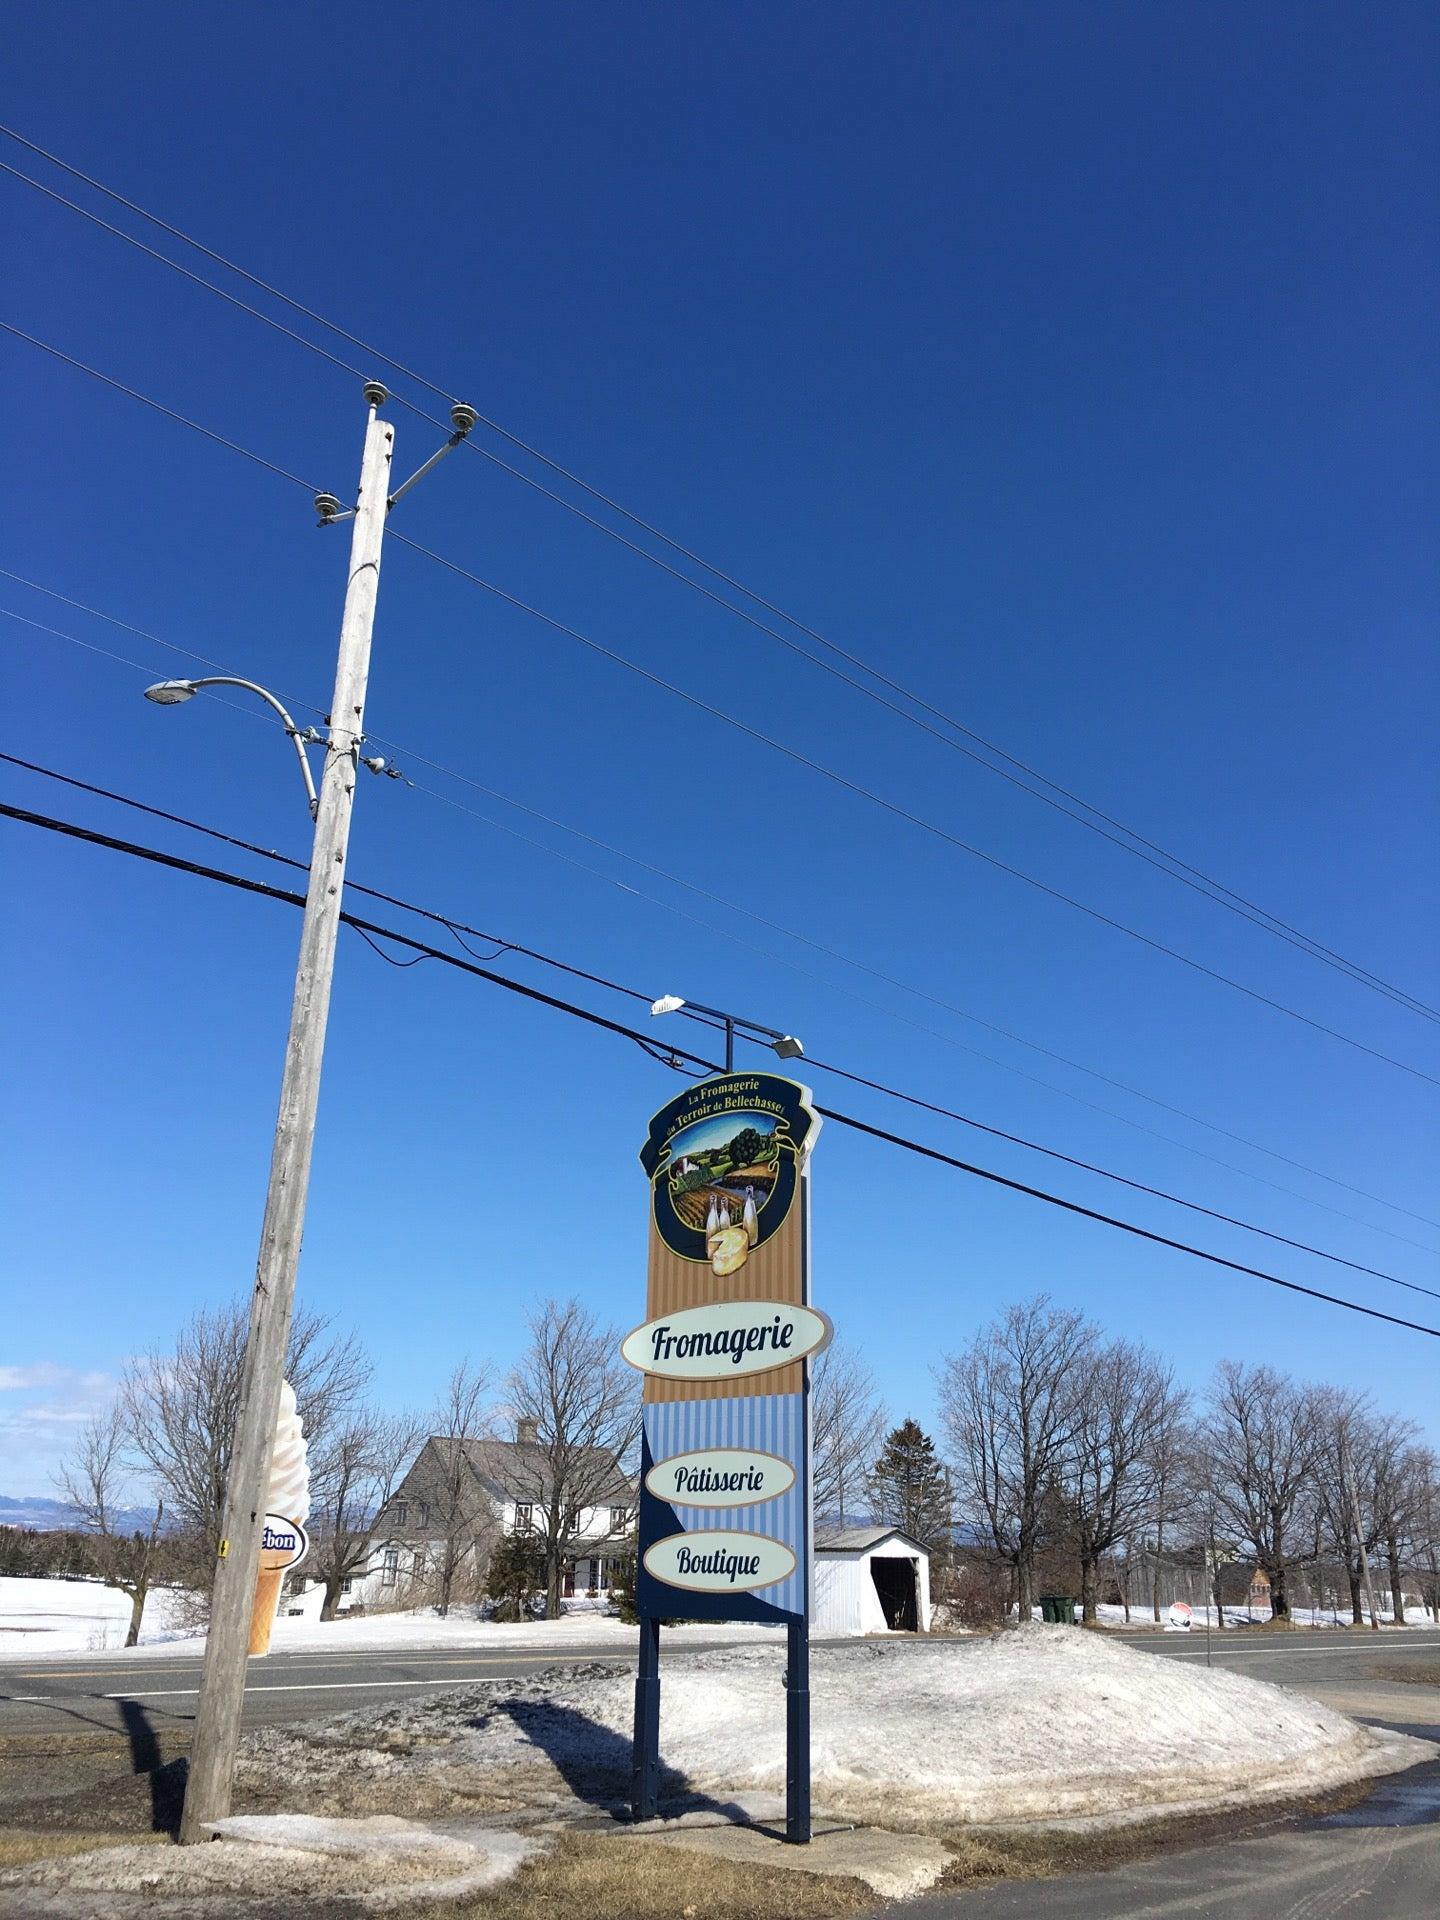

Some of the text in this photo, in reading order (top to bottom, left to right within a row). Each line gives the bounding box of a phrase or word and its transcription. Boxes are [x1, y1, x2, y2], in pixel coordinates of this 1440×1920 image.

[688, 1078, 760, 1105] La Fromagerie
[667, 1125, 676, 1136] du
[675, 1103, 712, 1126] Terroir
[713, 1101, 723, 1111] de
[724, 1095, 782, 1112] Bellechasse
[651, 1316, 794, 1364] Fromagerie
[674, 1466, 764, 1493] Pâtisserie
[676, 1547, 760, 1583] Boutique
